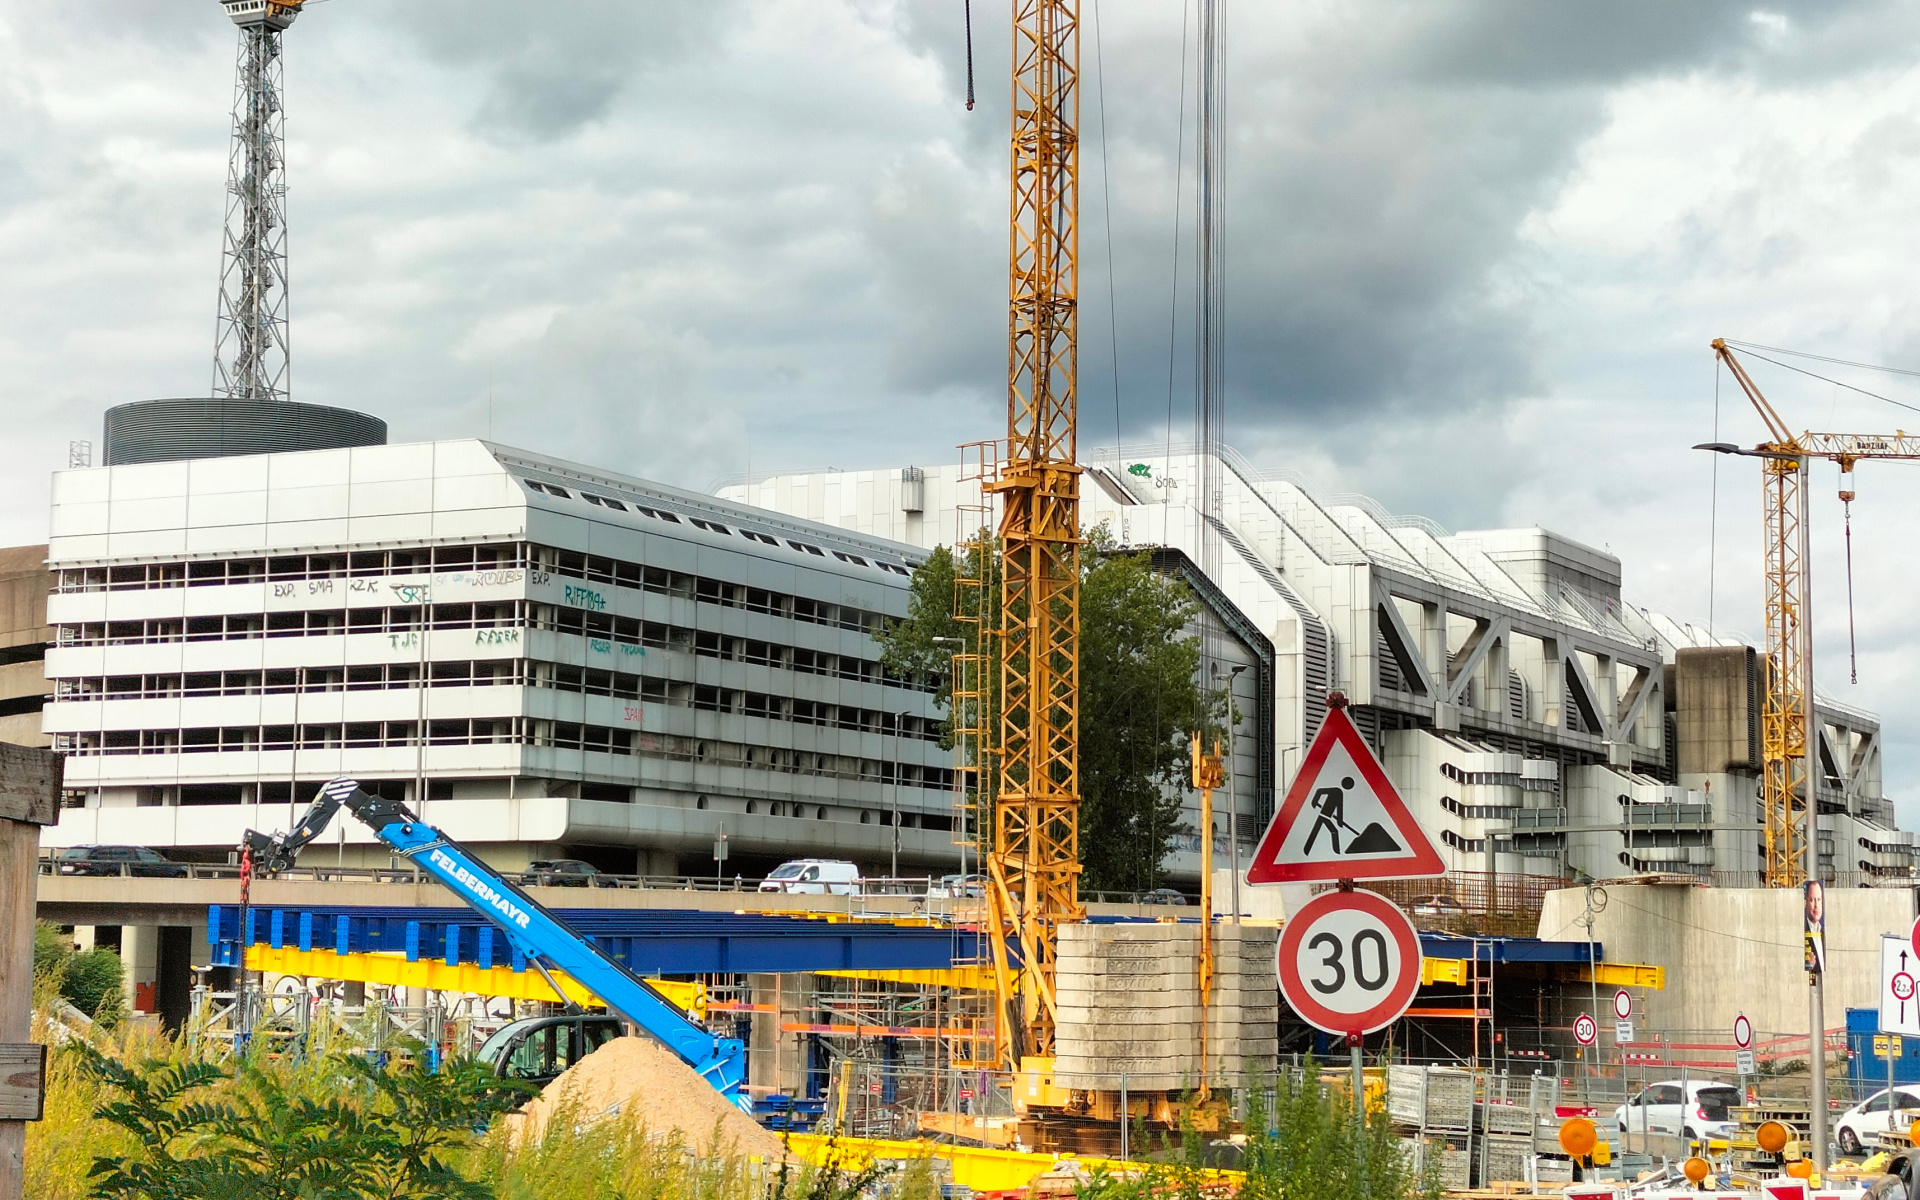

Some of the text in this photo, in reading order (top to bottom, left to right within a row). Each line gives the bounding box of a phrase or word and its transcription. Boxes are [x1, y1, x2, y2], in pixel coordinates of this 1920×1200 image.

[274, 582, 296, 598] EXP.
[429, 848, 531, 930] FELBERMAYR
[1307, 927, 1390, 995] 30
[1578, 1023, 1592, 1036] 30
[1875, 1040, 1901, 1051] doa
